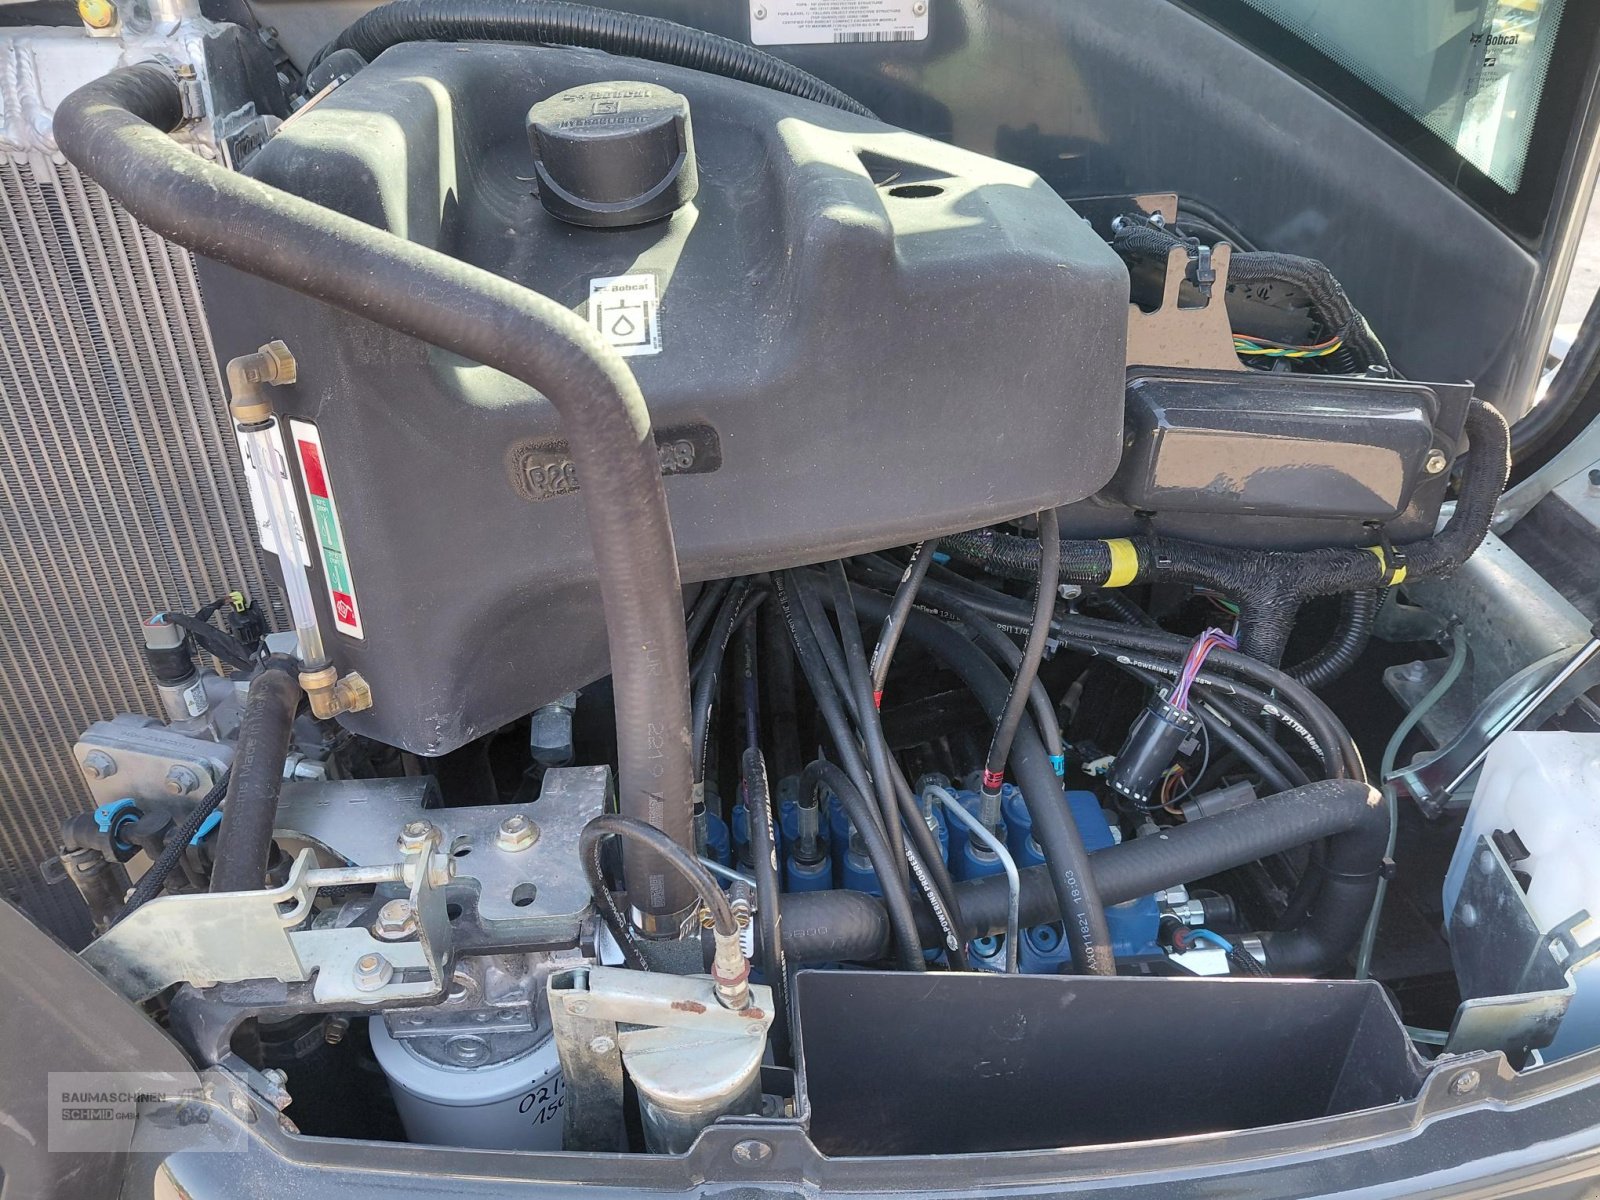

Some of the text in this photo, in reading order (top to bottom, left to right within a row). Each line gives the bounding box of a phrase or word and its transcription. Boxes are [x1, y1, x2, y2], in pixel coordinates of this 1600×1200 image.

[1485, 34, 1519, 46] Bobcat
[611, 283, 649, 293] Bobcat
[1132, 660, 1169, 675] POWERING
[252, 680, 270, 724] Mexico
[250, 722, 261, 737] in
[239, 738, 258, 778] Made
[925, 890, 951, 933] POWERING
[1064, 869, 1099, 971] AX011821 18:03
